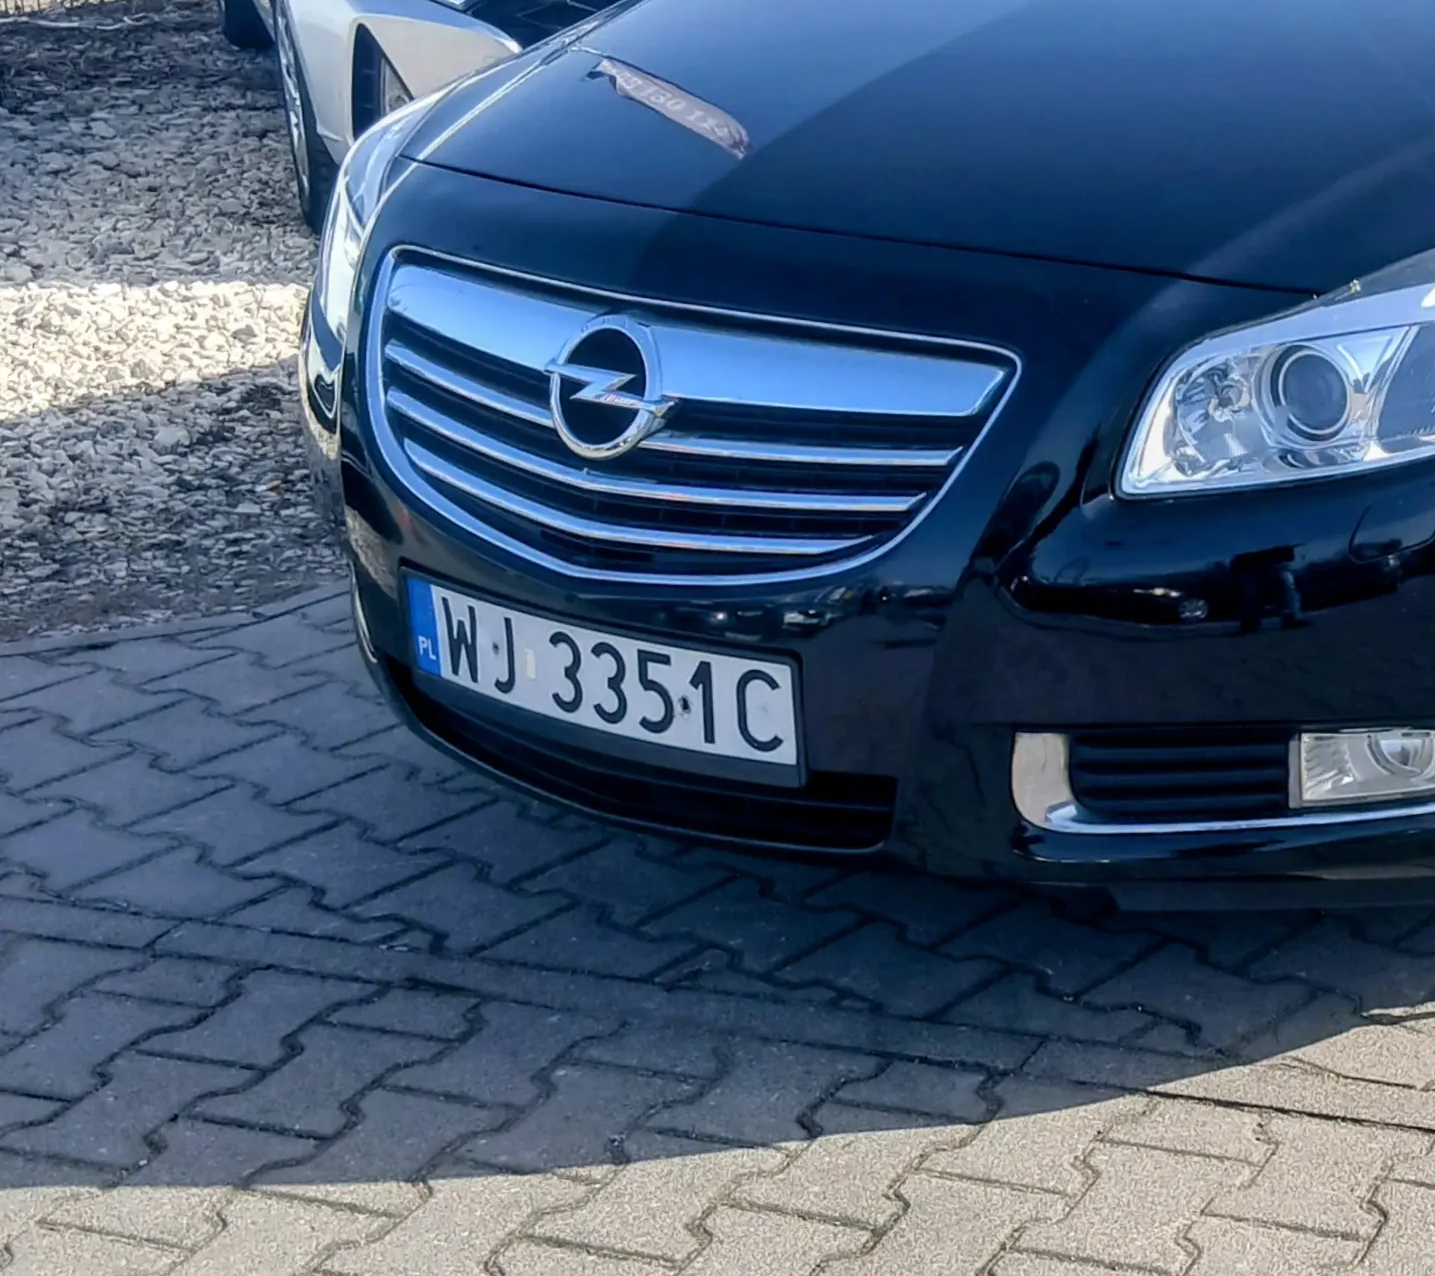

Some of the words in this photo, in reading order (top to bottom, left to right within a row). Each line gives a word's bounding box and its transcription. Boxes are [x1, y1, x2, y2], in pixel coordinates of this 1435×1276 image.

[418, 636, 437, 661] PL
[441, 596, 517, 695] WJ
[548, 631, 784, 753] 3351C
